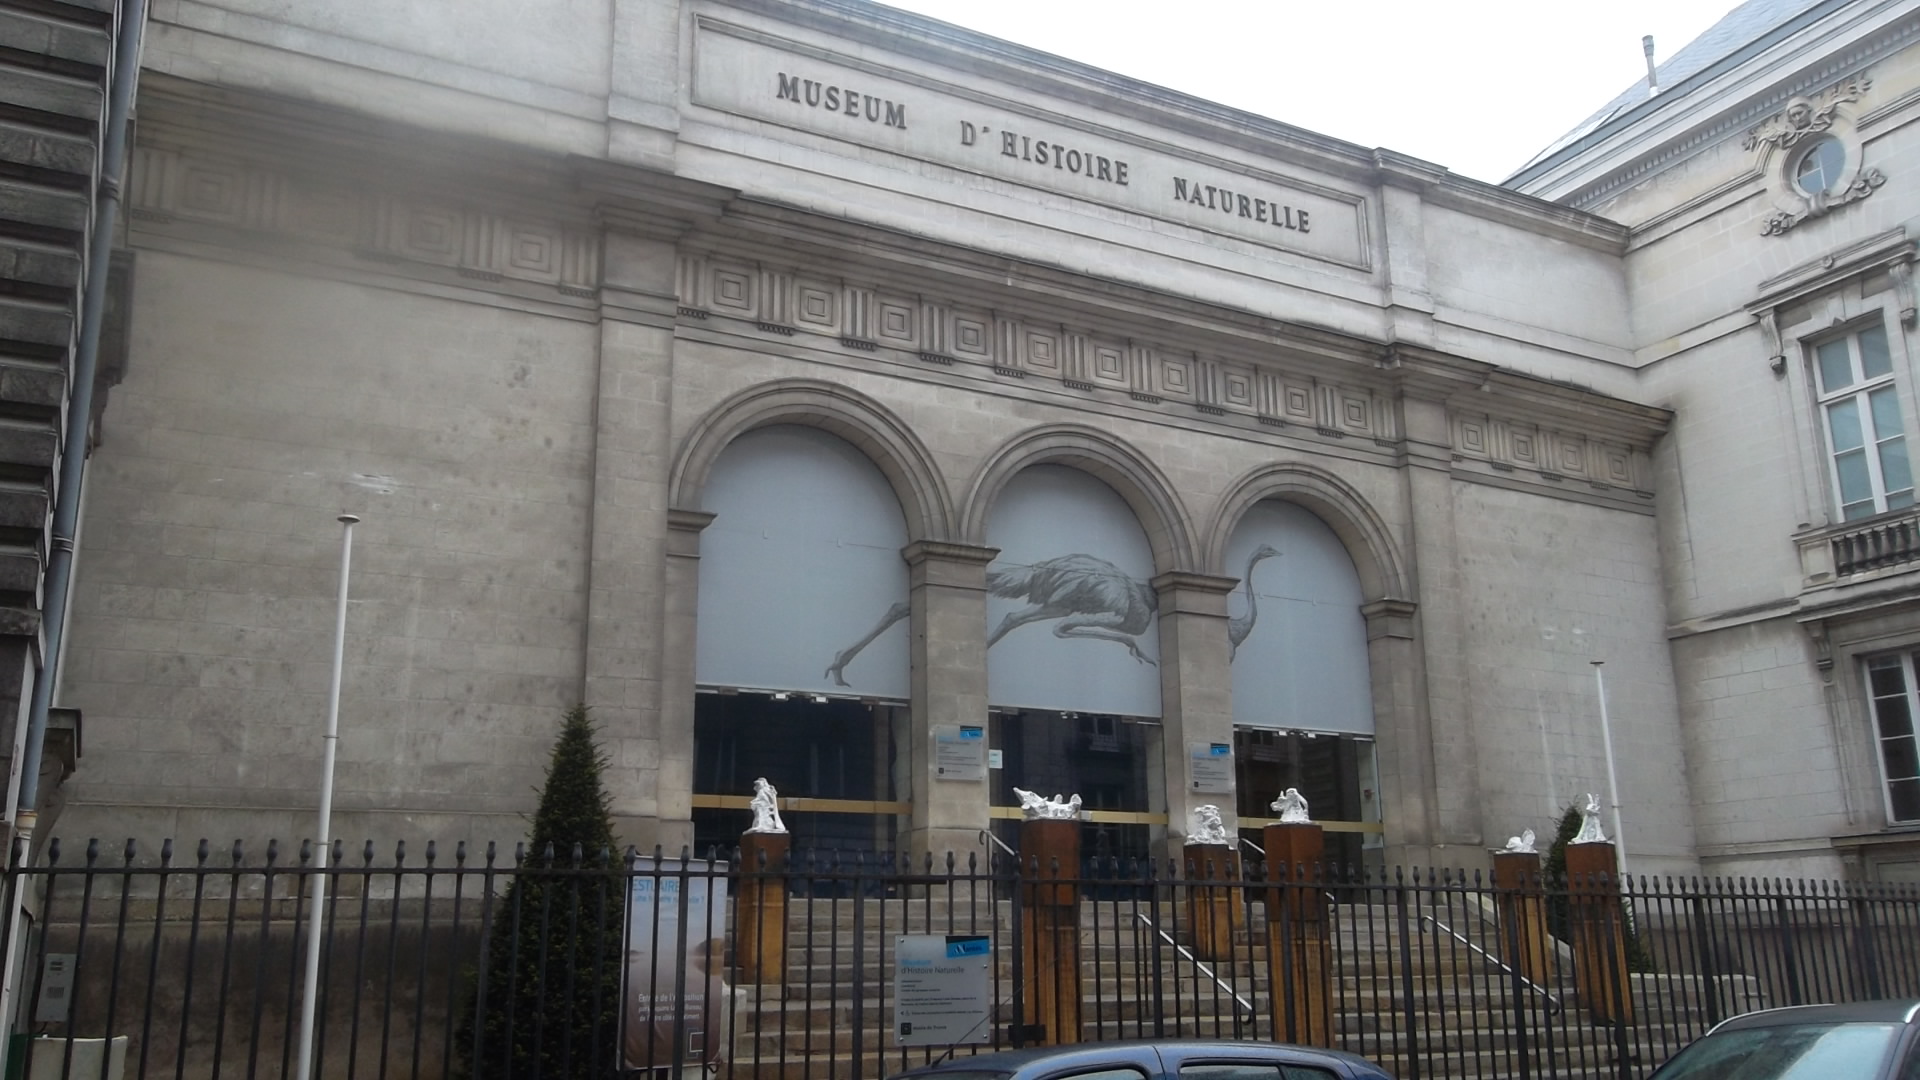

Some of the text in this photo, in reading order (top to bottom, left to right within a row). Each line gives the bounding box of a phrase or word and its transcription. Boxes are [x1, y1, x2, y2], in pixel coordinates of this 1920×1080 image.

[777, 72, 907, 129] MUSEUM
[1173, 176, 1311, 233] NATURELLE
[934, 966, 964, 974] Naturelle
